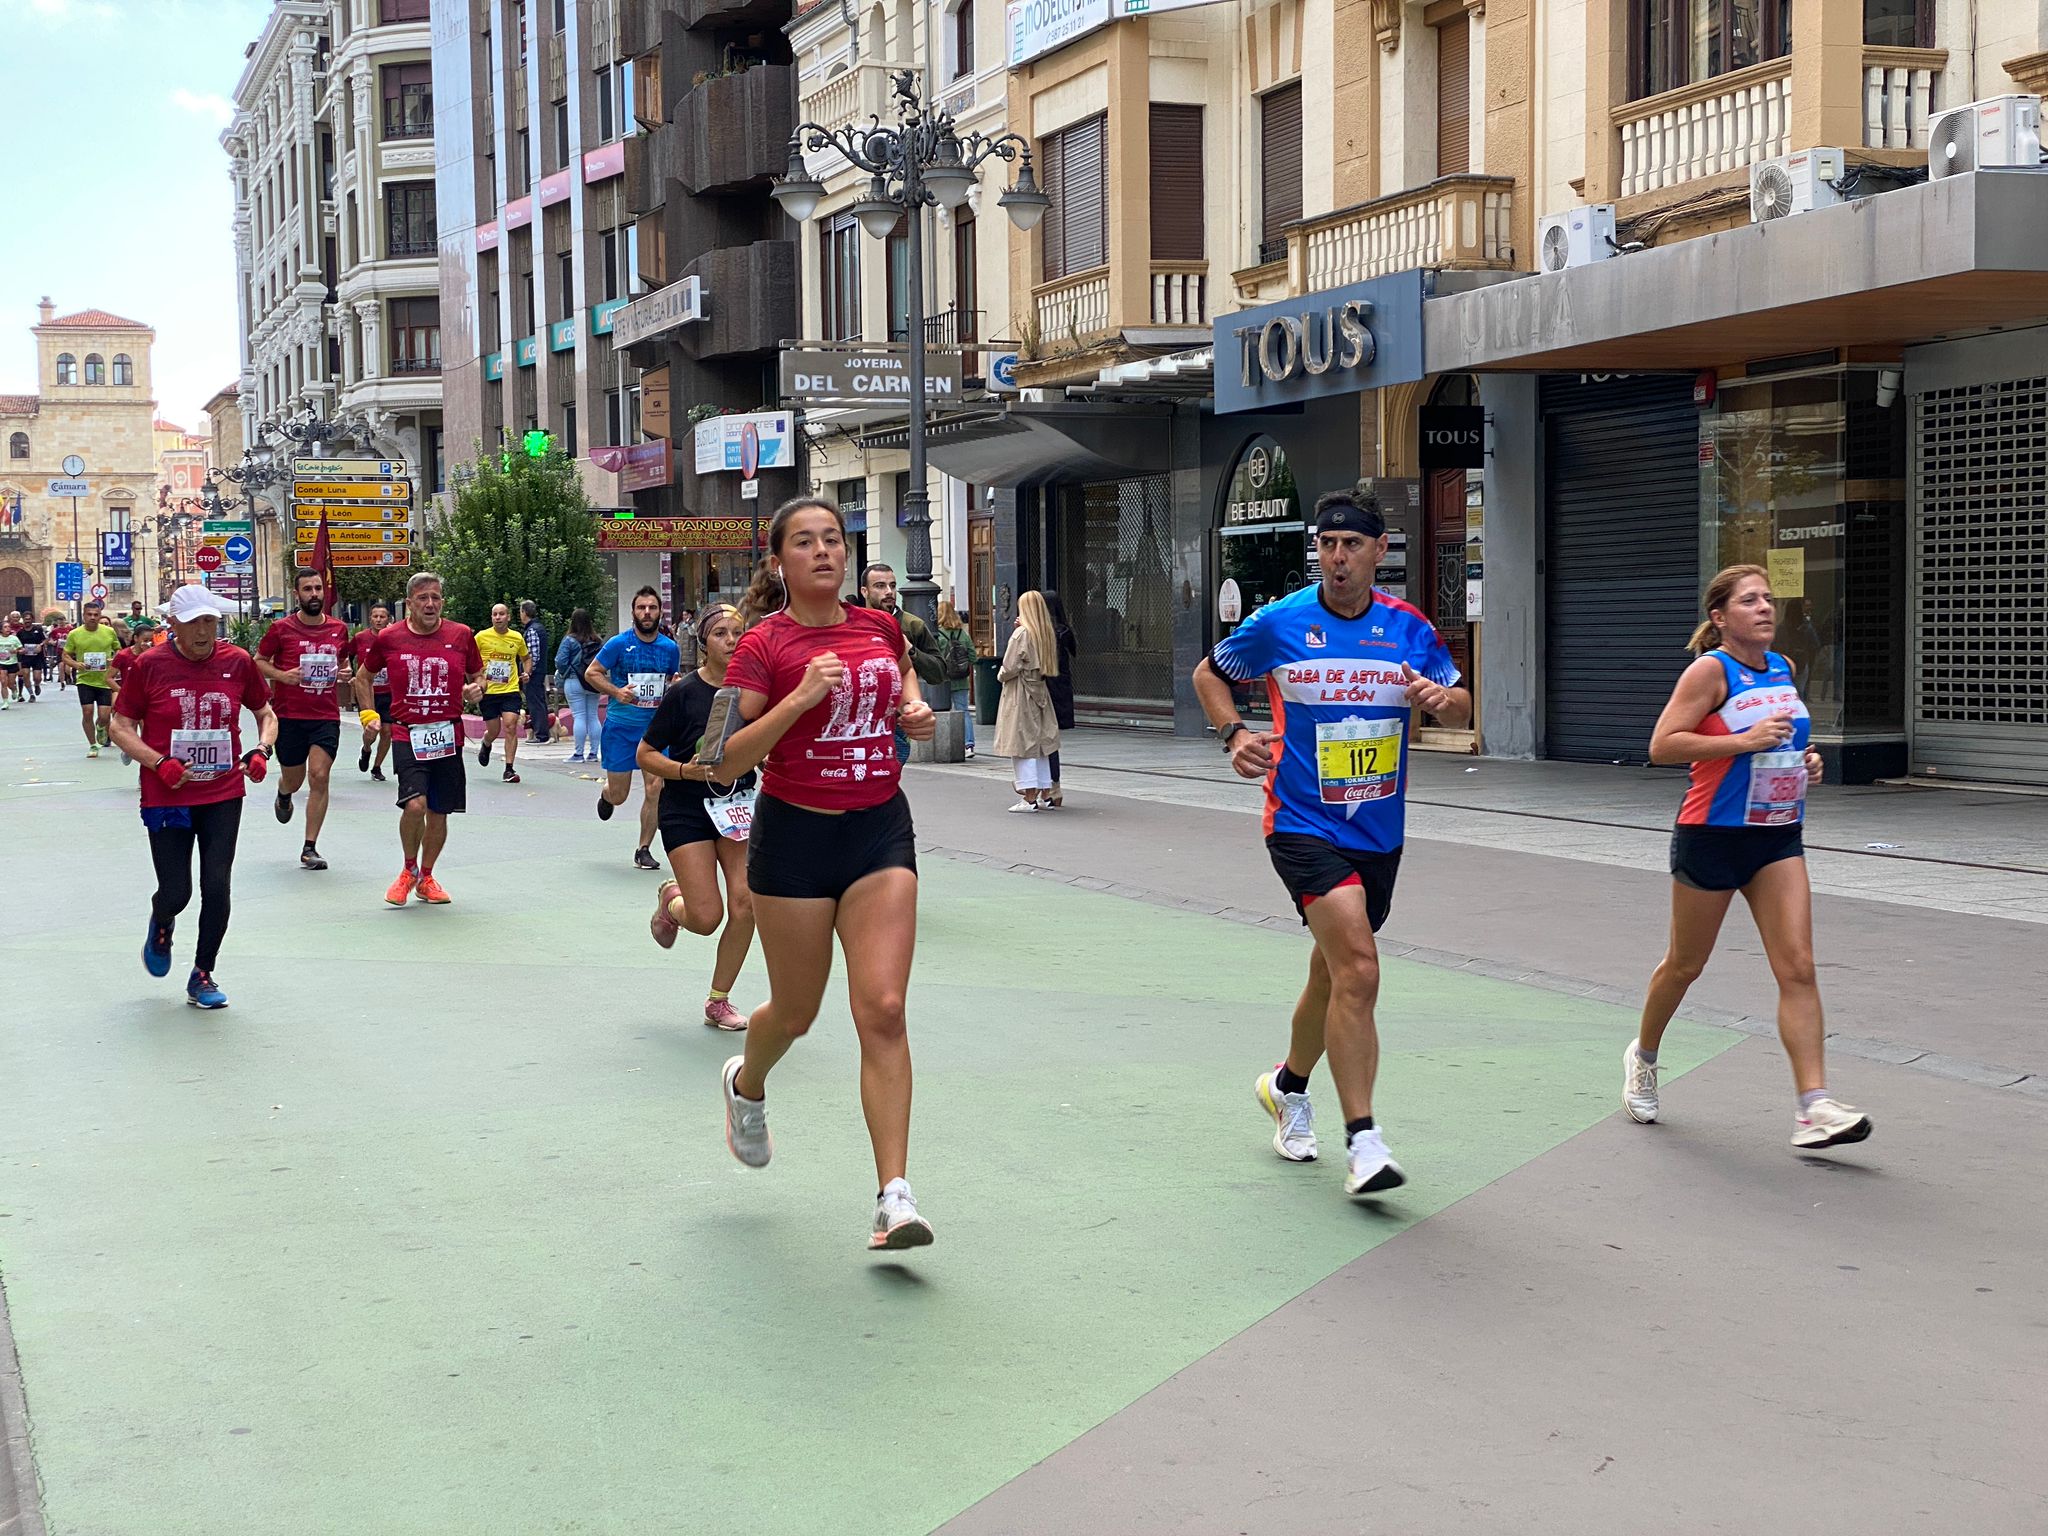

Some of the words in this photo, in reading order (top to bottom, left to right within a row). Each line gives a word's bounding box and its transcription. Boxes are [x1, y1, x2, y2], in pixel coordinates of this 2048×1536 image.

[1232, 300, 1376, 388] TOUS
[844, 358, 903, 369] JOYERIA
[794, 374, 839, 392] DEL
[1425, 430, 1480, 444] TOUS
[1251, 458, 1264, 477] BE
[297, 486, 323, 494] Conde
[327, 486, 346, 494] Luna
[332, 509, 352, 517] León
[839, 501, 866, 513] ESTRELLA
[1231, 503, 1246, 520] BE
[1247, 498, 1290, 520] BEAUTY
[601, 520, 664, 532] ROYAL
[310, 665, 330, 677] 265
[492, 668, 505, 676] 384
[1288, 669, 1320, 683] CASA
[1326, 669, 1345, 684] DE
[1350, 670, 1410, 687] ASTURIA
[639, 684, 655, 697] 516
[1320, 686, 1376, 702] LEÓN
[423, 731, 446, 747] 484
[187, 747, 218, 764] 300
[1350, 747, 1378, 776] 112
[726, 806, 752, 824] 665
